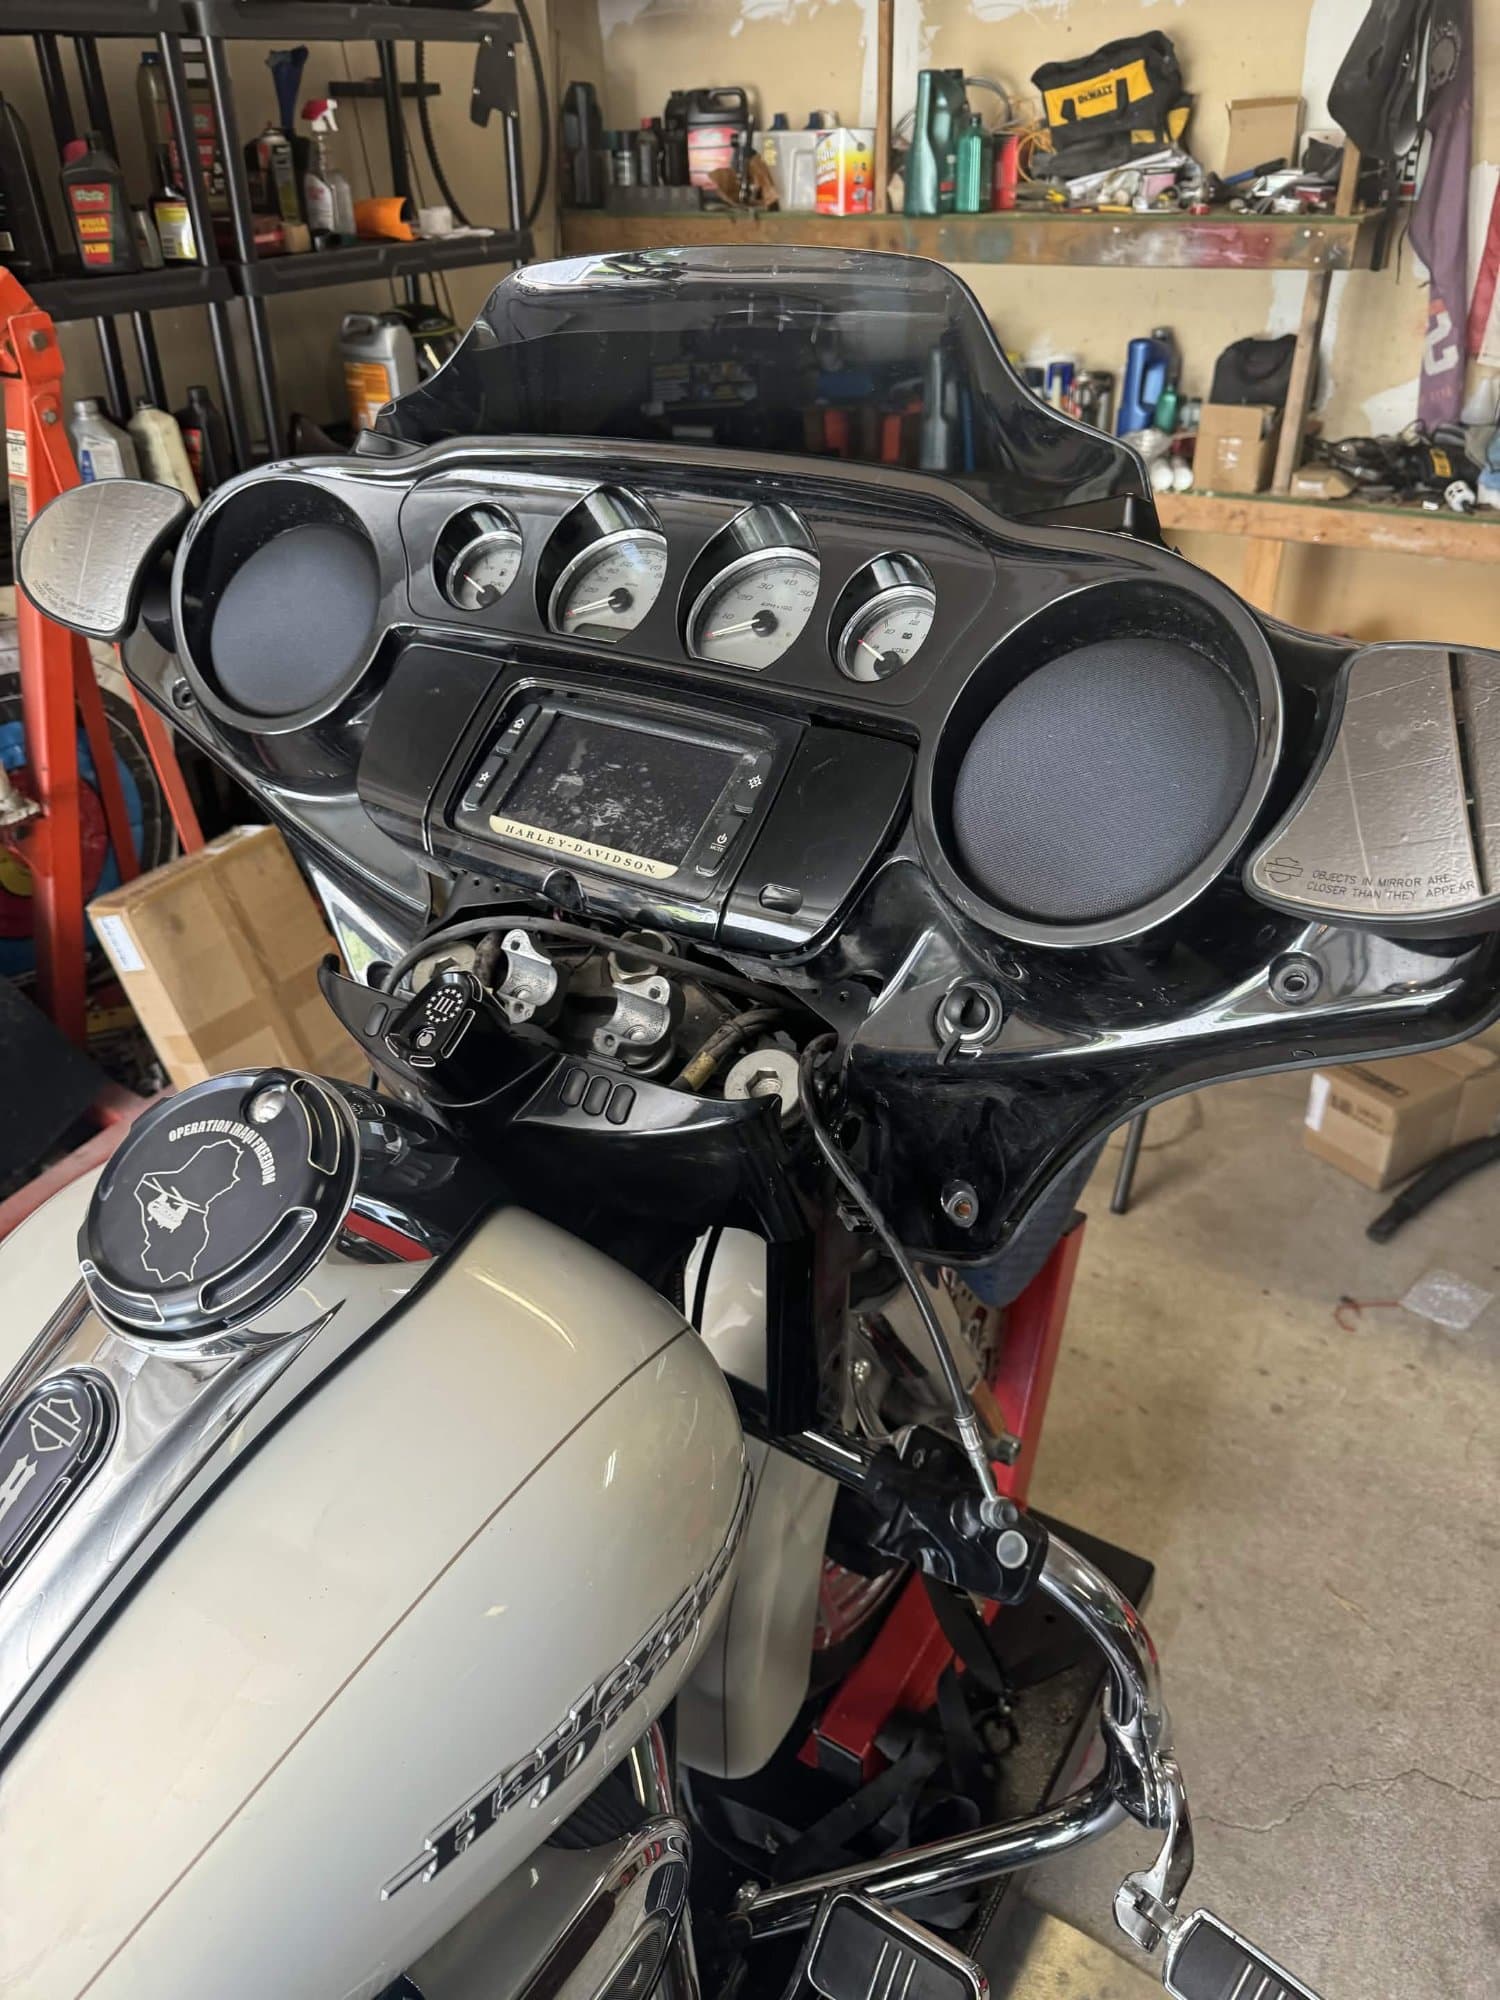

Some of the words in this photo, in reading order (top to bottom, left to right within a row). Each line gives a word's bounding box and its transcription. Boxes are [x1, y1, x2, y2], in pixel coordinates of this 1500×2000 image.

[757, 582, 774, 590] 30
[505, 823, 656, 874] HARLEY-DAVIDSON
[1312, 870, 1357, 885] OBJECTS
[1361, 876, 1373, 886] IN
[1378, 876, 1421, 888] MIRROR
[1428, 873, 1452, 885] ARE
[1306, 881, 1347, 895] CLOSER
[1352, 888, 1382, 898] THAN
[1387, 890, 1417, 901] THEY
[1426, 880, 1476, 898] APPEAR
[168, 1119, 233, 1142] OPERATION
[228, 1121, 260, 1145] IRAQI
[250, 1136, 277, 1186] FREEDOM
